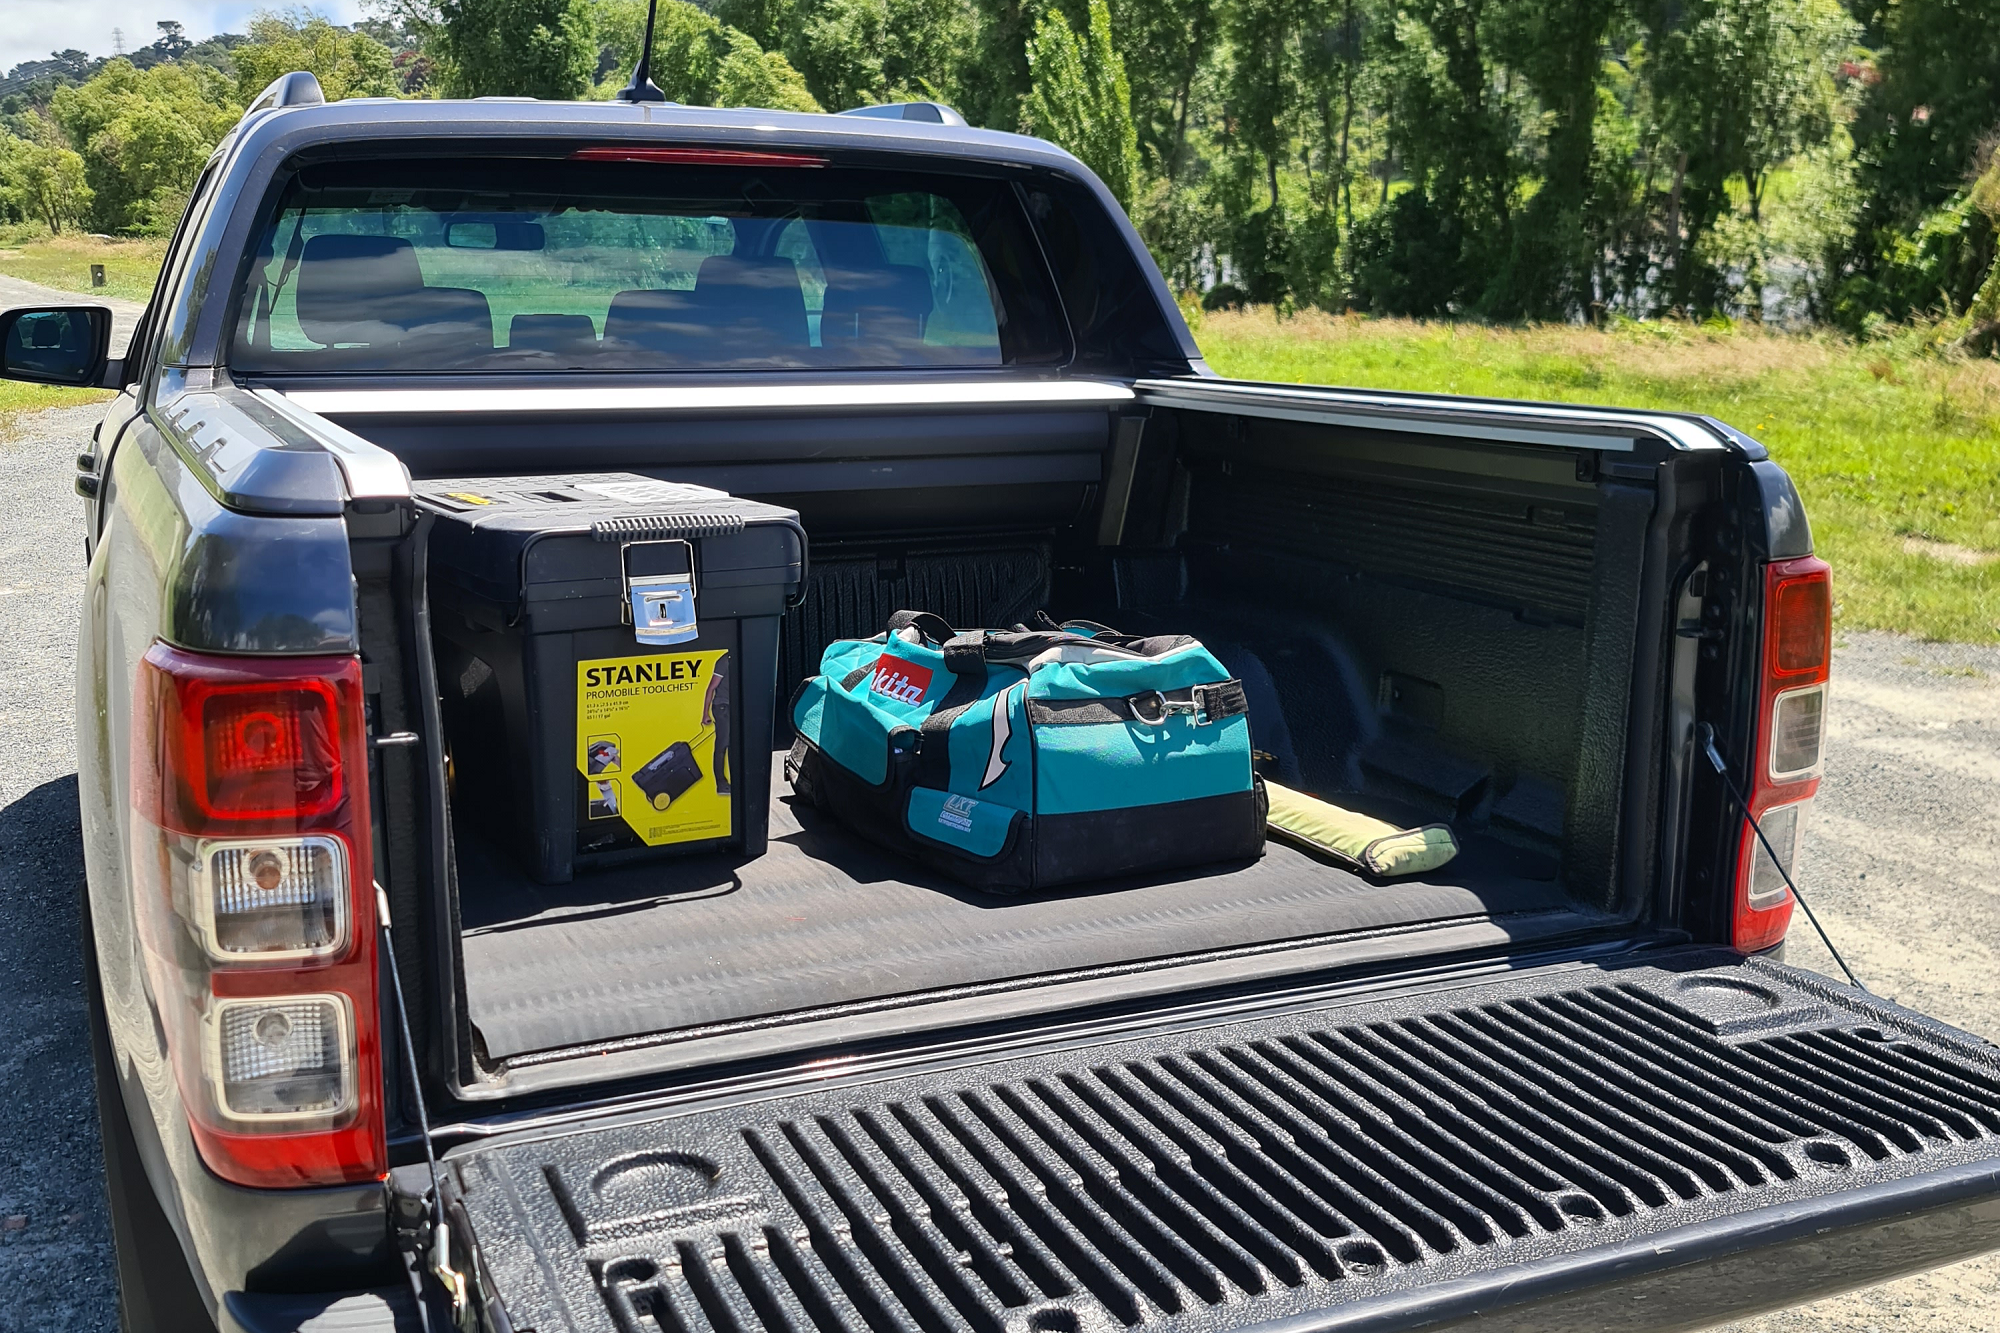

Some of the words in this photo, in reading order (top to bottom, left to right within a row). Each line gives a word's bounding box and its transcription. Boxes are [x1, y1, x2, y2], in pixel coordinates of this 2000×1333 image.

[586, 659, 702, 687] STANLEY
[586, 687, 640, 700] PROMOBILE
[642, 682, 694, 694] TOOLCHEST
[870, 667, 923, 708] kita
[943, 794, 979, 818] LXT
